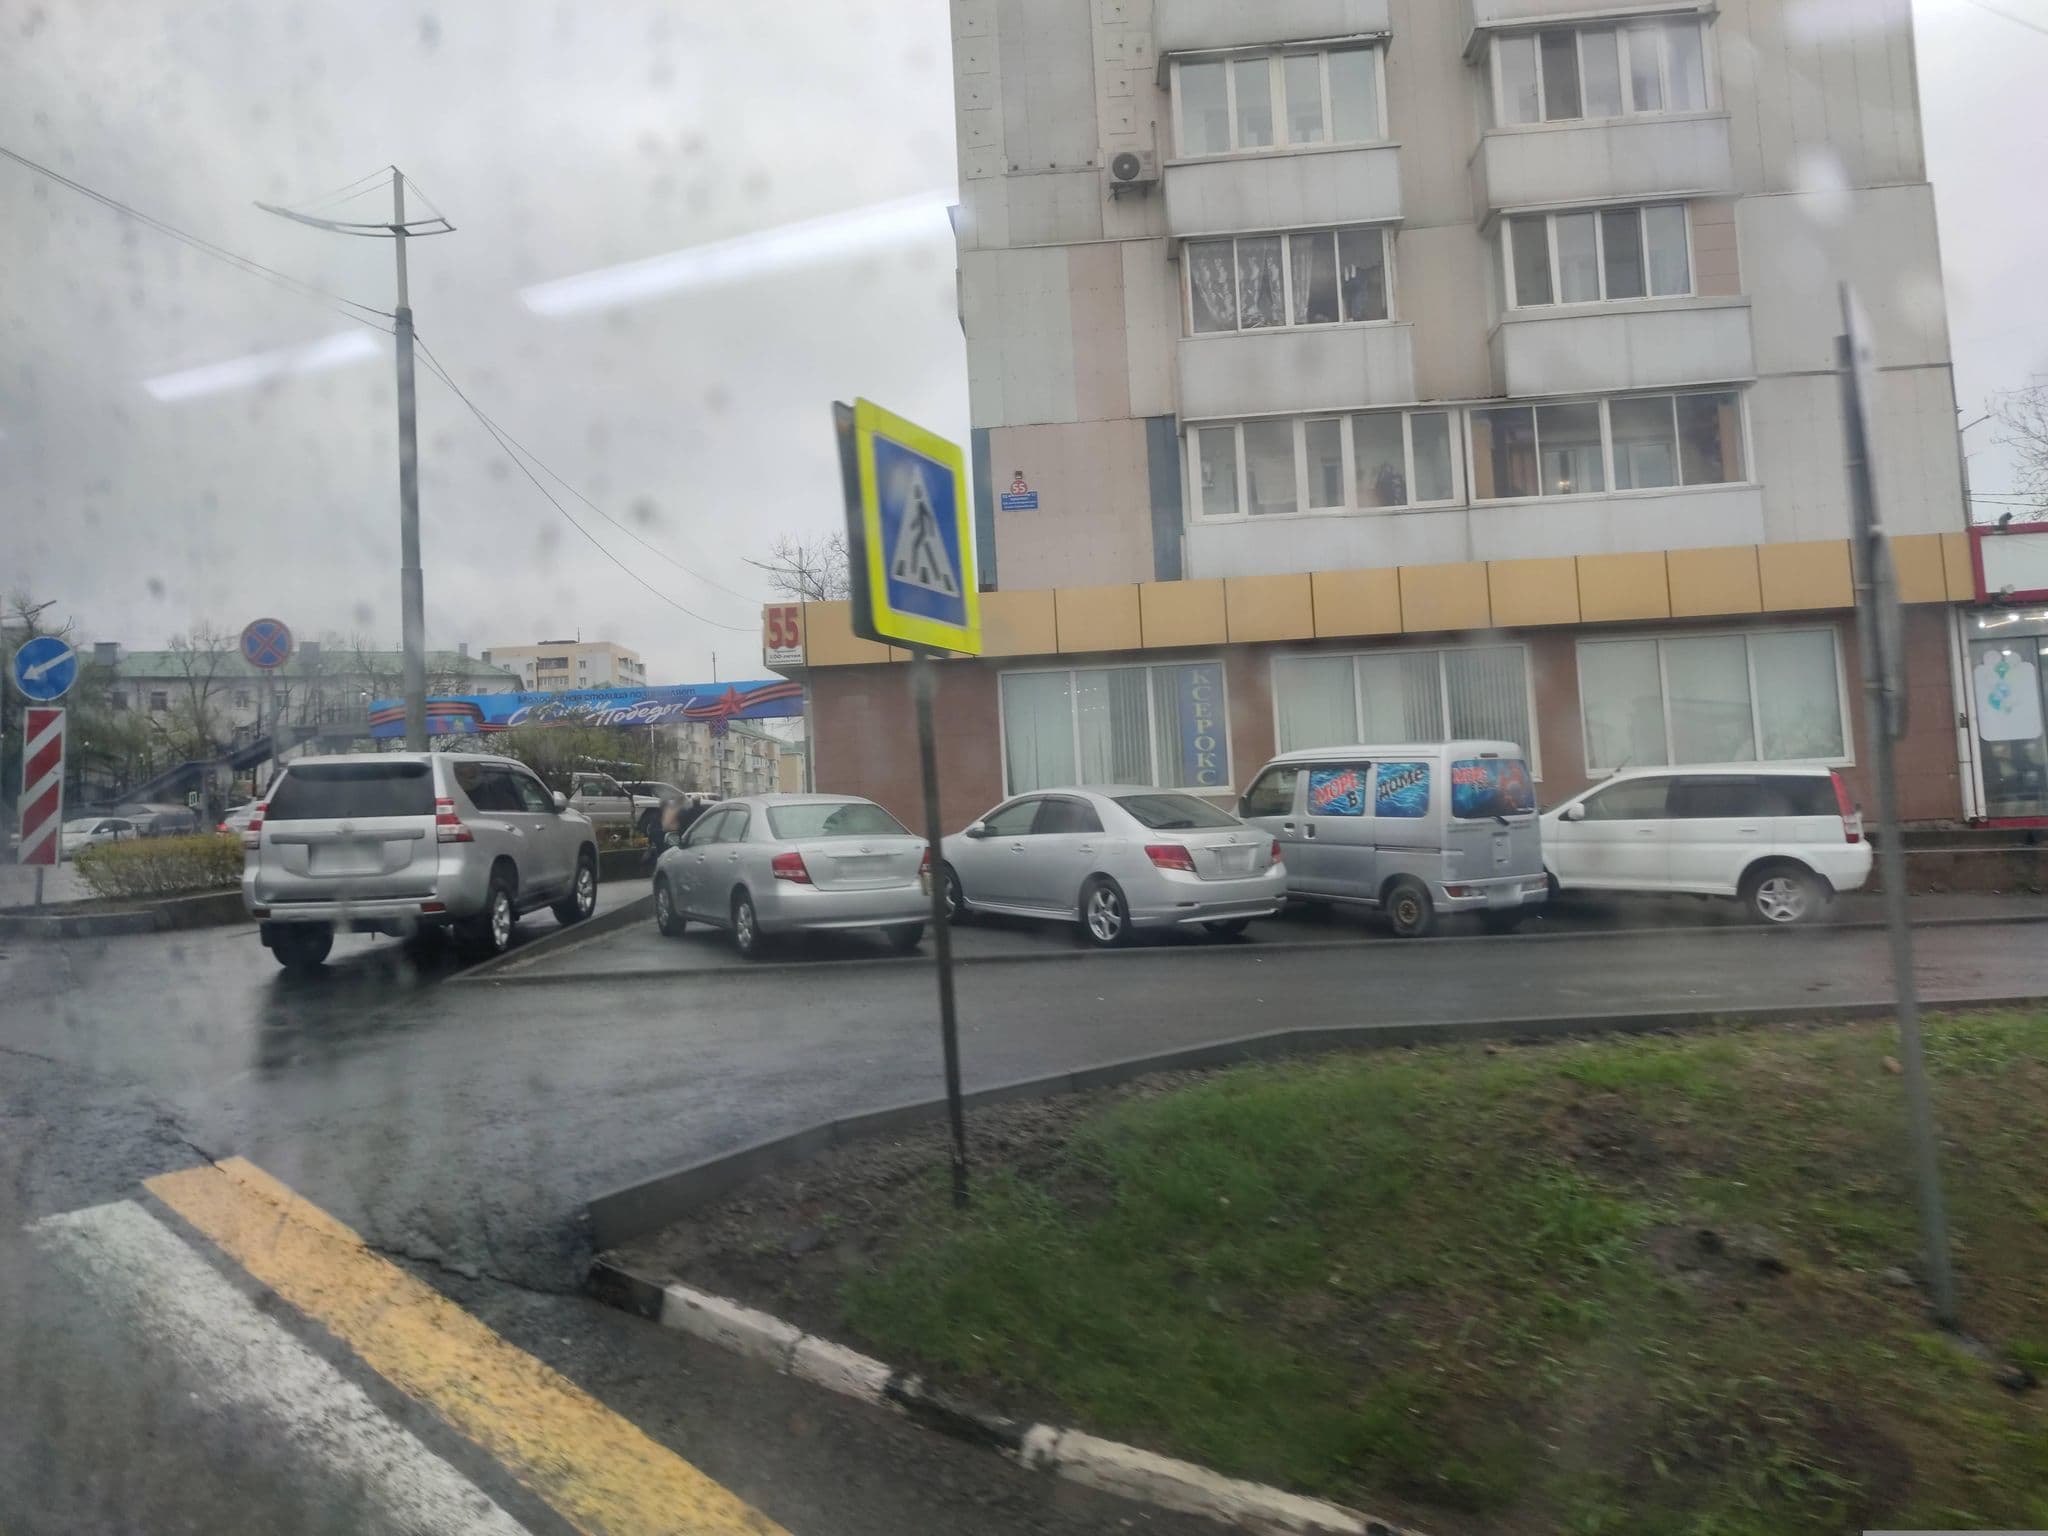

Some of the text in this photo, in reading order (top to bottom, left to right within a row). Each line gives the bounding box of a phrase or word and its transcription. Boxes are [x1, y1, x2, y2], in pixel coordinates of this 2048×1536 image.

[1012, 482, 1026, 494] 55
[768, 606, 799, 649] 55
[584, 696, 697, 727] Победы!
[1191, 669, 1217, 785] КСЕРОКС
